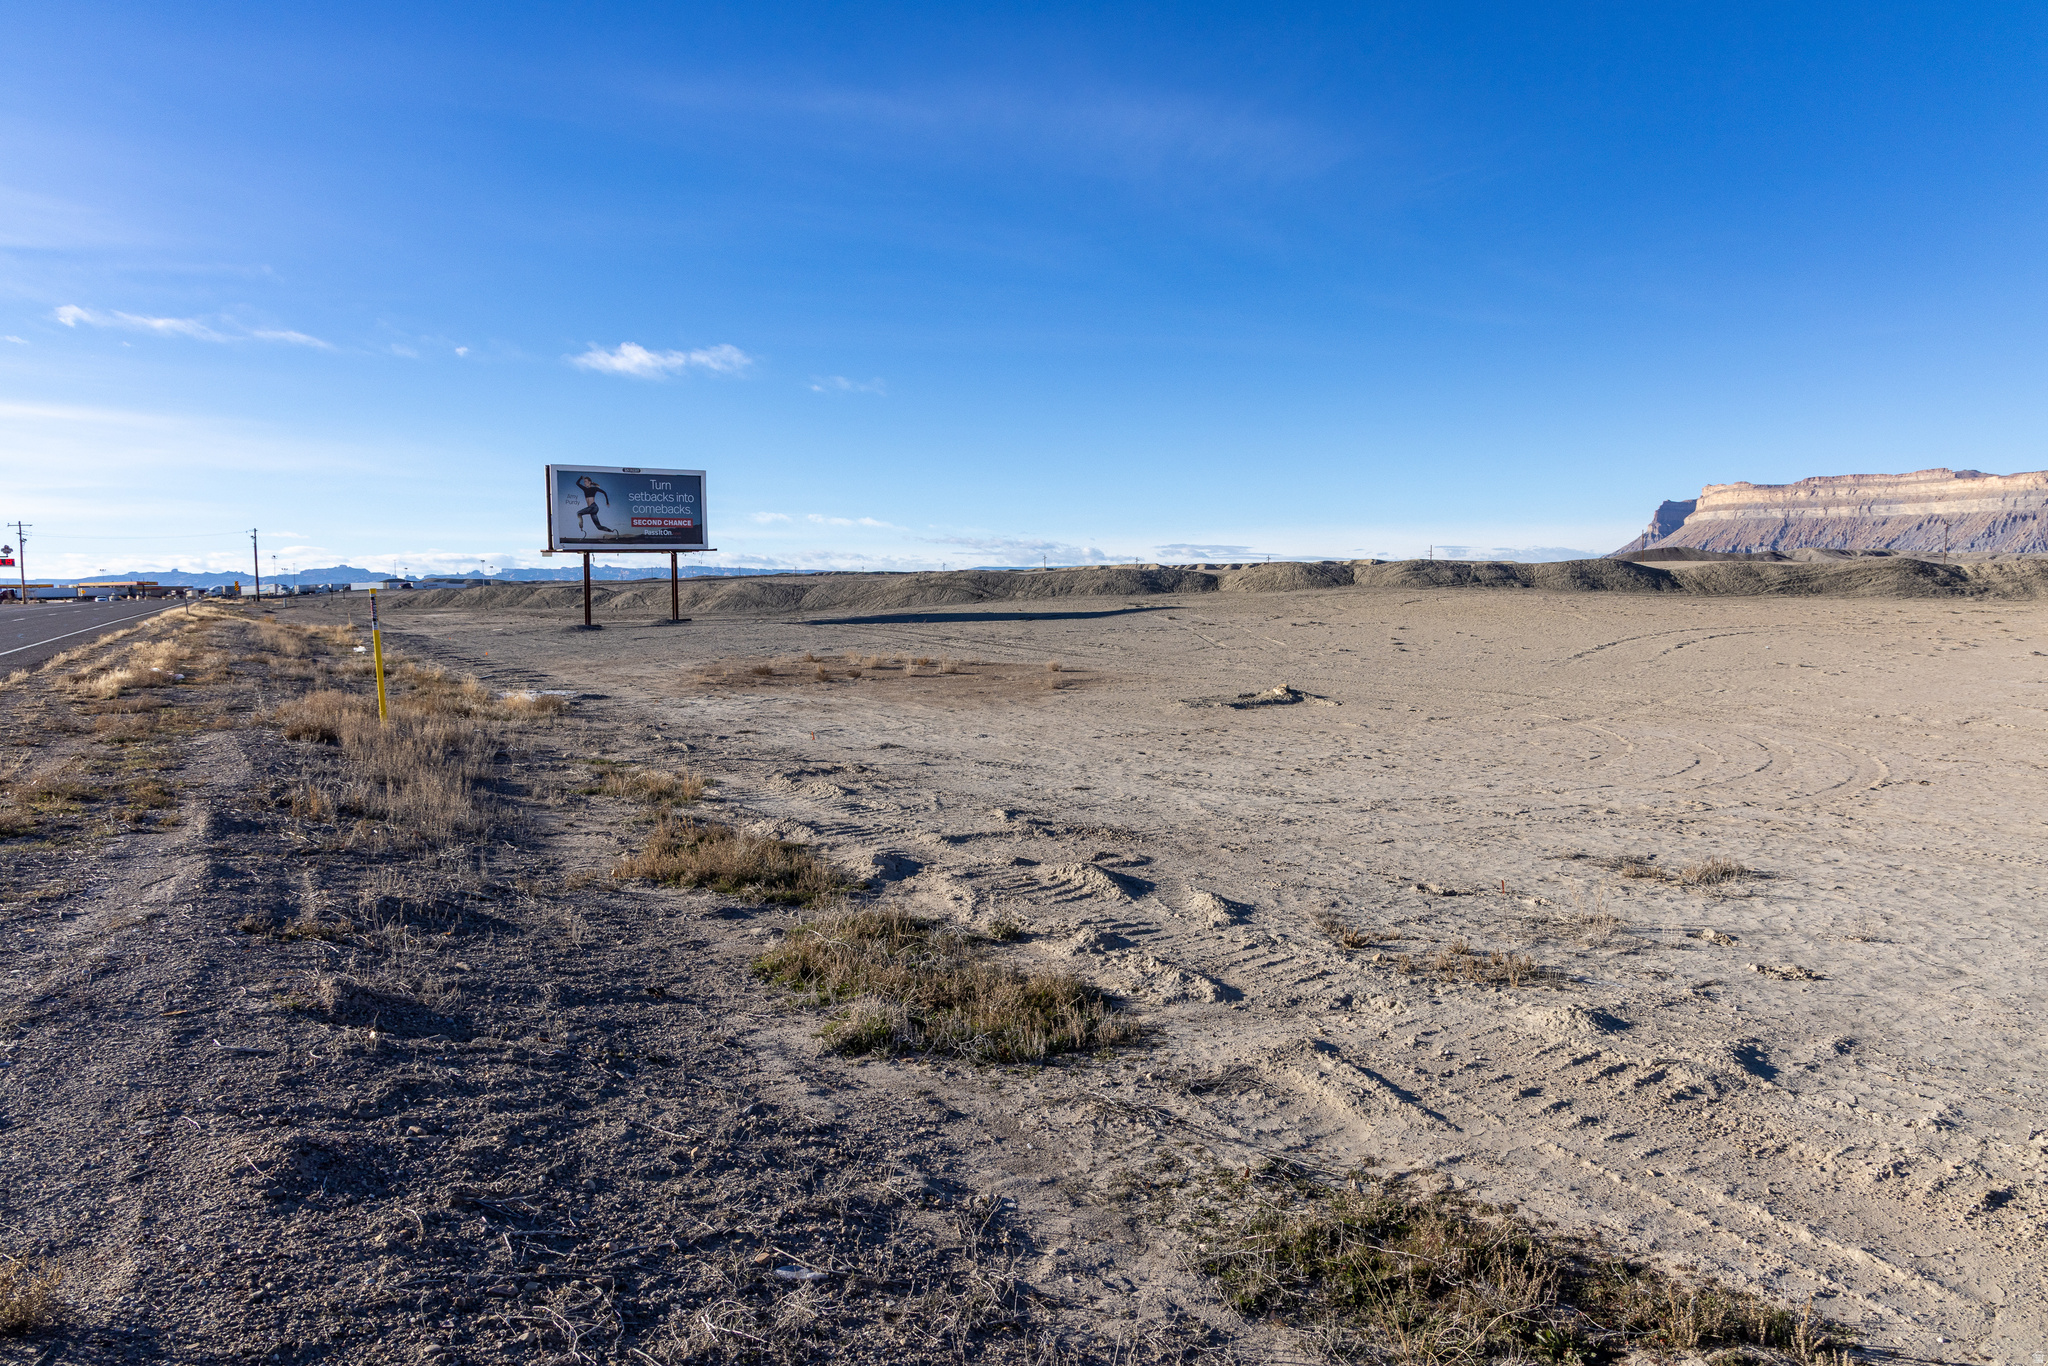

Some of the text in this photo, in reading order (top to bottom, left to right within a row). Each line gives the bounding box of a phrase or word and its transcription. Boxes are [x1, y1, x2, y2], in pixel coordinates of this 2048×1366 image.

[650, 479, 671, 490] Turn
[628, 492, 694, 503] setbacks into
[632, 504, 693, 515] comebacks.
